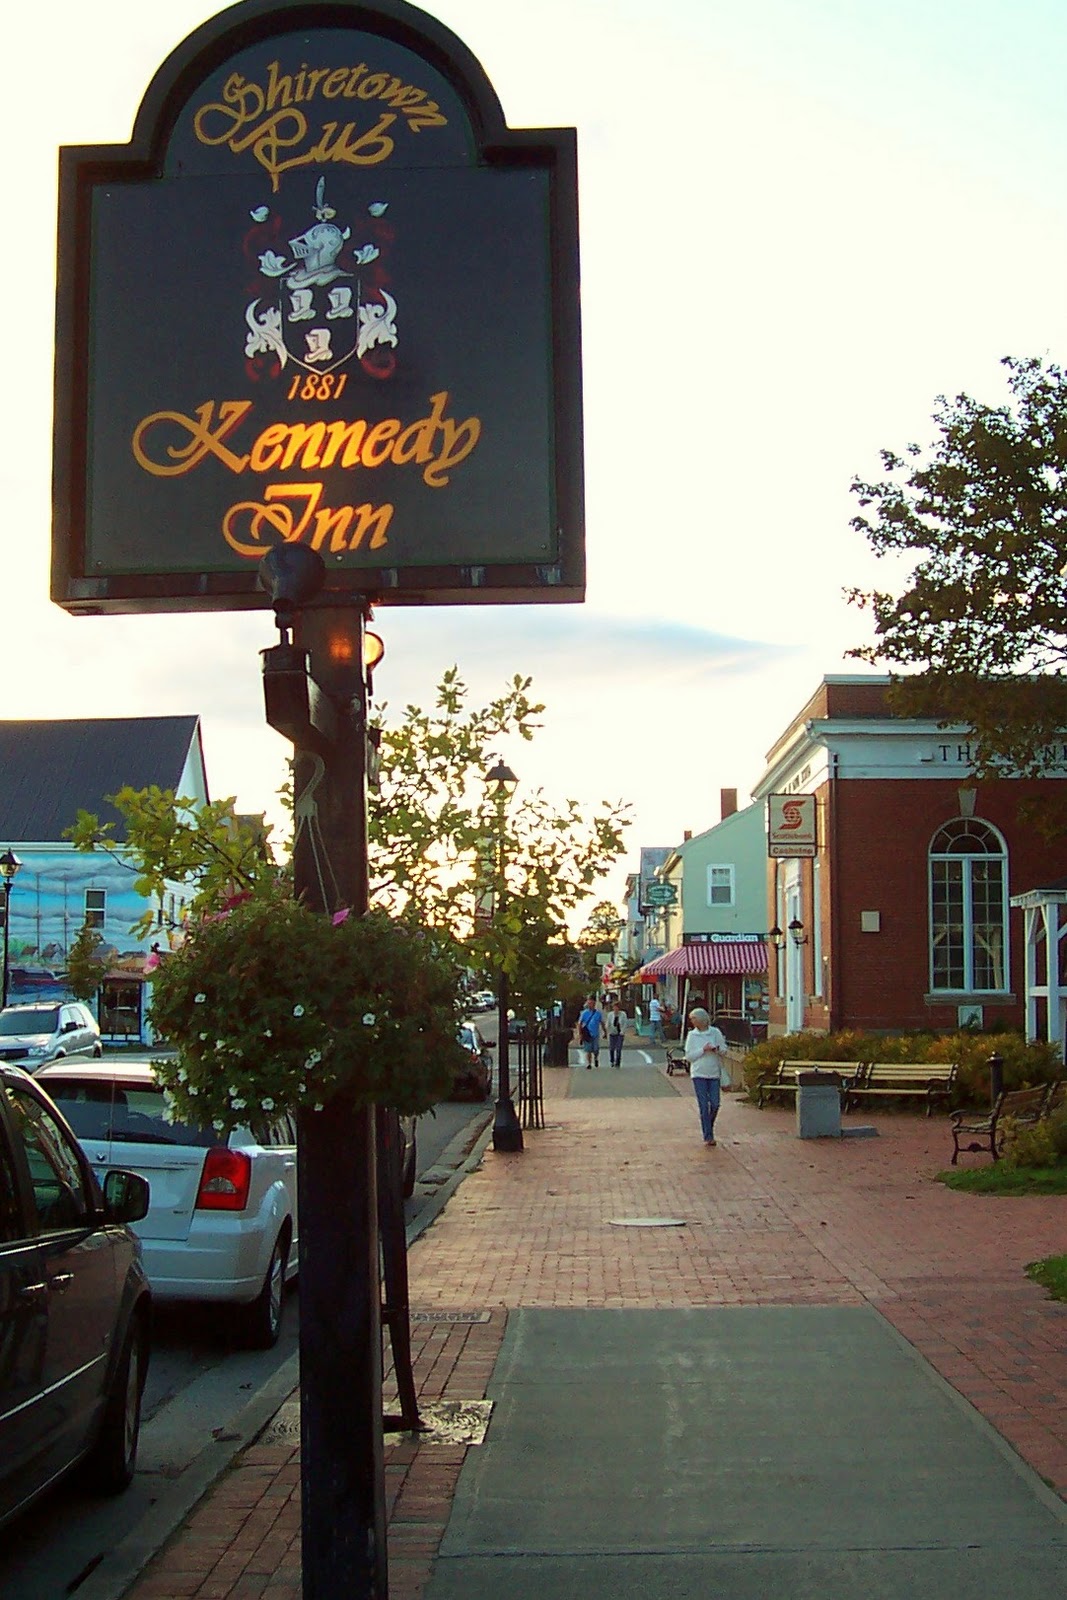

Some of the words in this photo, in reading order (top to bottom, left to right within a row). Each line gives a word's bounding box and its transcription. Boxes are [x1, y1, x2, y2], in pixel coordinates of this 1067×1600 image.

[194, 60, 449, 145] Shiretown
[229, 107, 398, 192] Pub
[286, 373, 347, 401] 1881
[131, 391, 482, 488] Kennedy
[221, 482, 395, 559] Inn
[710, 933, 759, 943] Guardian
